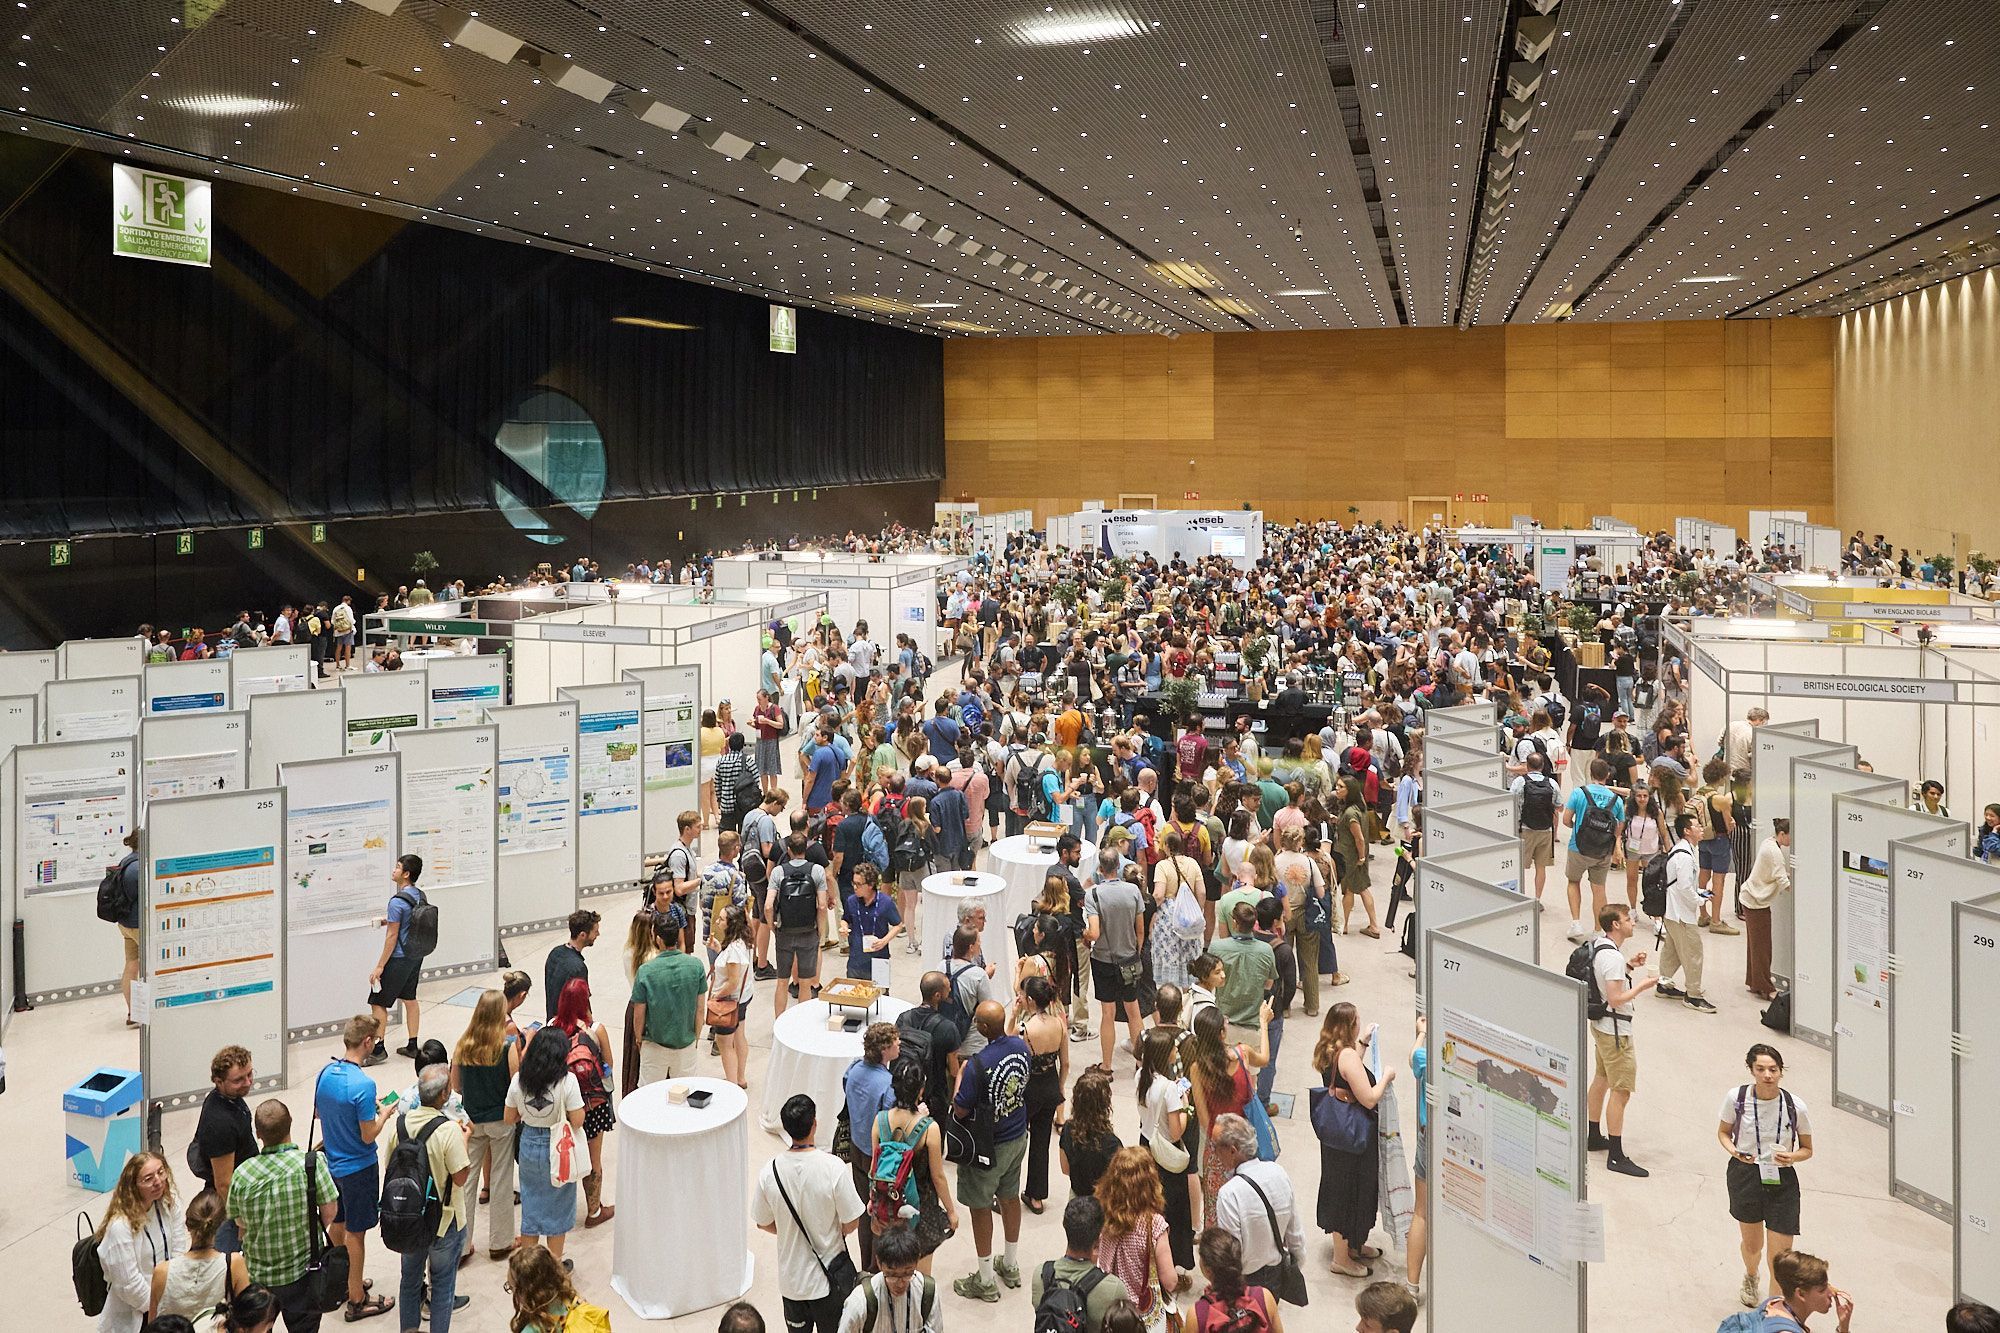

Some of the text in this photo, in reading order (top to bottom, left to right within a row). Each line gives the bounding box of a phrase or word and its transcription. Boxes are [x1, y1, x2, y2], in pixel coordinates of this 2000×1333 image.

[120, 227, 152, 238] SORTIDA
[123, 235, 203, 253] SALIDA DE EMERGENCIA
[138, 247, 176, 258] EMERGENCY
[1198, 516, 1224, 524] eseb
[424, 623, 447, 631] WILEY
[1804, 680, 1835, 692] BRITISH
[1837, 682, 1888, 694] ECOLOGICAL
[1890, 683, 1926, 695] SOCIETY
[374, 765, 389, 773] 257
[1803, 772, 1817, 781] 293
[1433, 790, 1443, 799] 271
[257, 801, 274, 810] 255
[1497, 809, 1509, 818] 283
[1847, 812, 1863, 822] 295
[1432, 830, 1445, 840] 273
[1501, 860, 1513, 870] 281
[1907, 869, 1924, 880] 297
[1430, 880, 1445, 893] 275
[1516, 924, 1529, 937] 279
[1973, 934, 1995, 948] 299
[1443, 958, 1461, 972] 277
[1840, 1026, 1853, 1038] S23
[1900, 1103, 1915, 1114] S23
[1969, 1215, 1986, 1228] S23
